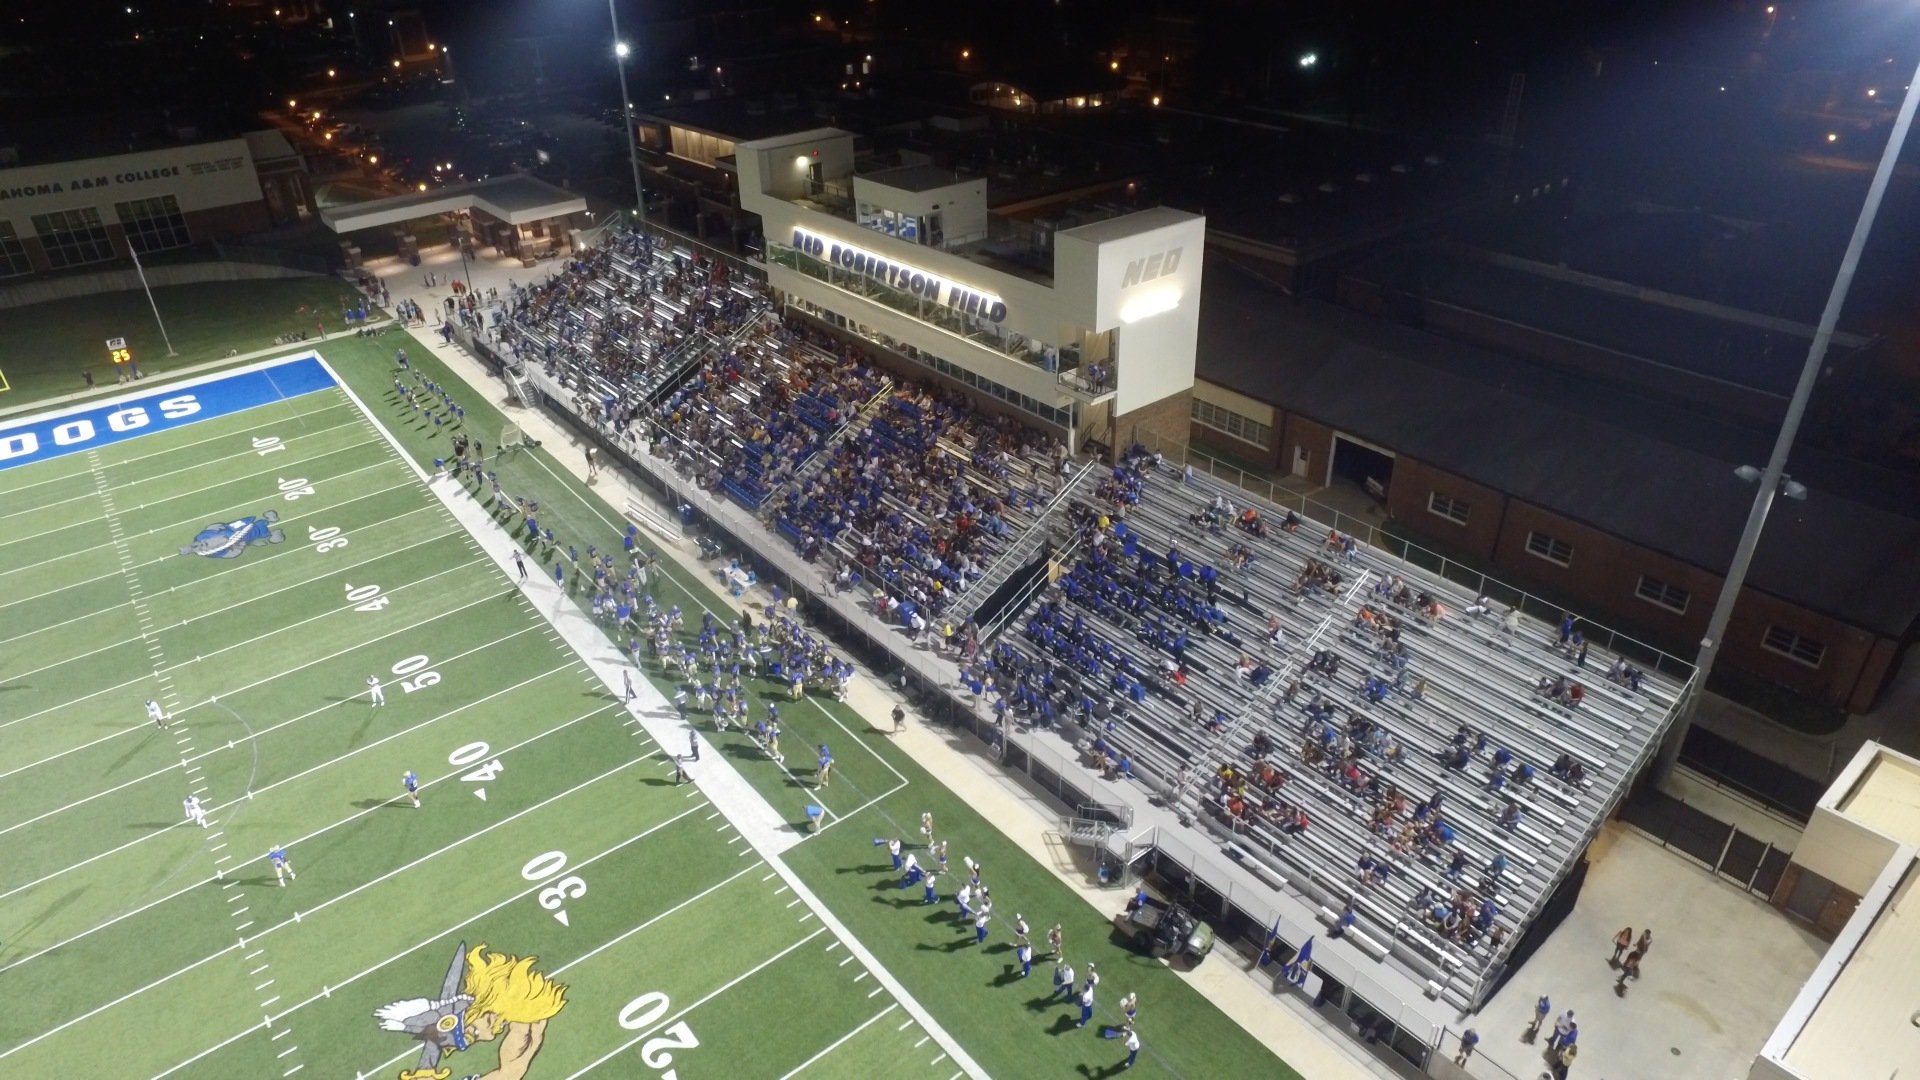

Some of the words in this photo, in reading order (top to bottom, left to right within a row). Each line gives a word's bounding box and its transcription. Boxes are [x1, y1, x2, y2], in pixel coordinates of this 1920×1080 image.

[71, 175, 109, 191] A&M
[116, 166, 180, 184] COLLEGE
[793, 230, 824, 256] RED
[831, 244, 940, 300] ROBERTSON
[948, 286, 1007, 323] FIELD
[1121, 246, 1184, 289] NEO
[112, 349, 131, 363] 25
[0, 394, 202, 461] DOGS
[253, 436, 286, 456] 10
[280, 478, 315, 501] 20
[309, 526, 348, 553] 30
[346, 585, 390, 612] 40
[391, 654, 441, 693] 50
[448, 741, 504, 783] 40
[521, 850, 587, 910] 30
[618, 991, 700, 1069] 20
